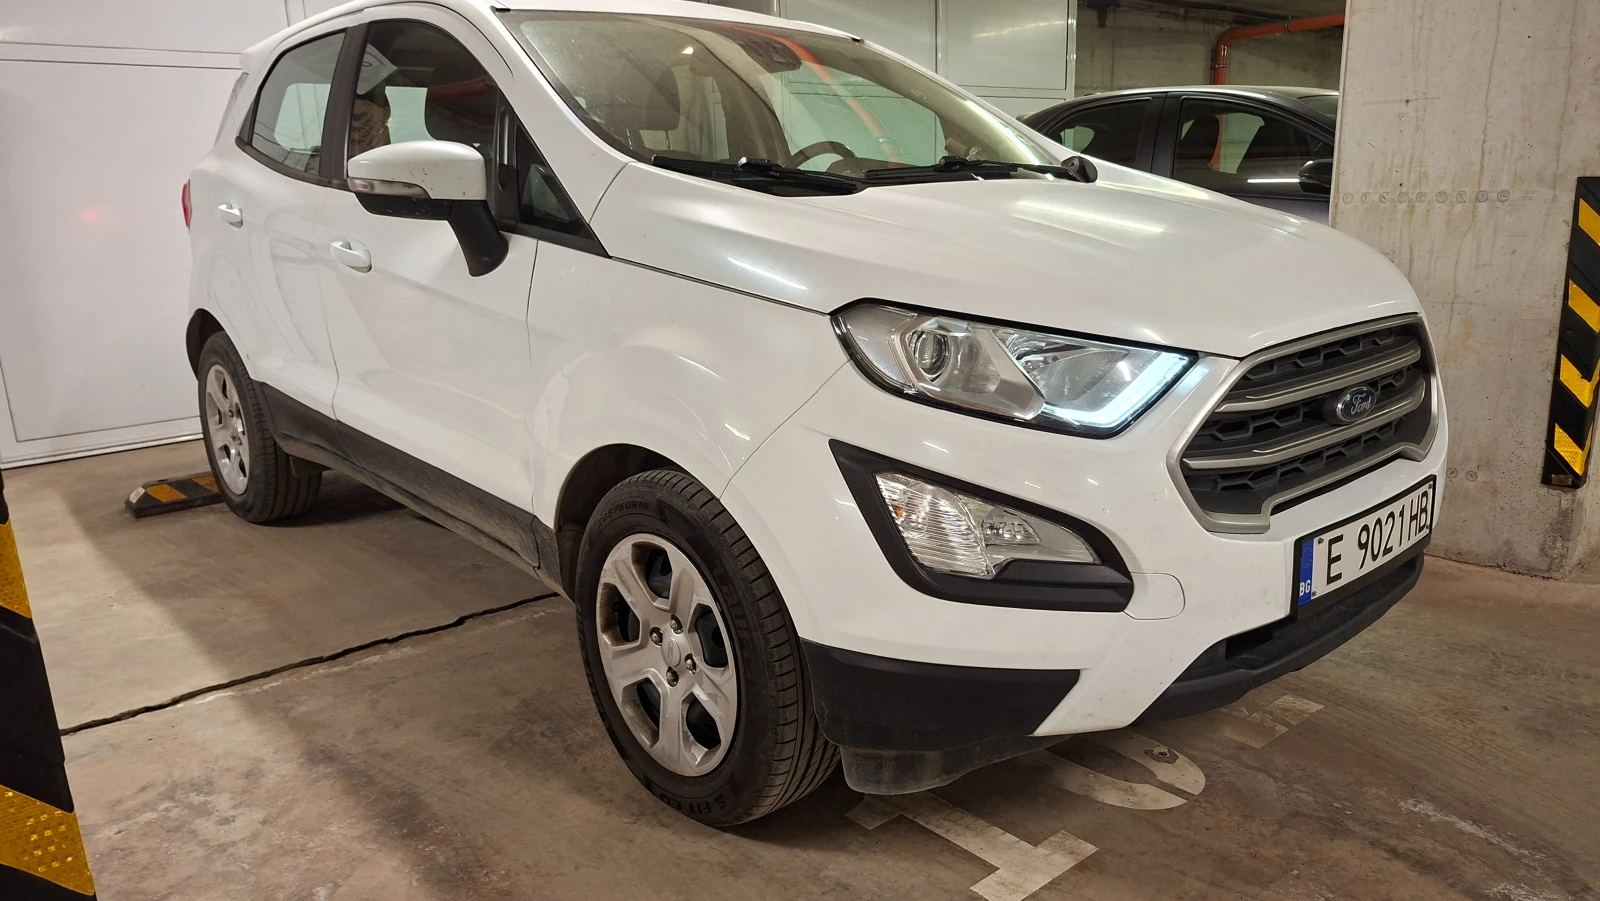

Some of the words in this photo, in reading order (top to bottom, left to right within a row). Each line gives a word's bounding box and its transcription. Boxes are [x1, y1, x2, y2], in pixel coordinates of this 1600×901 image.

[1351, 393, 1371, 415] Ford
[1327, 534, 1344, 586] E
[1299, 579, 1311, 597] BG
